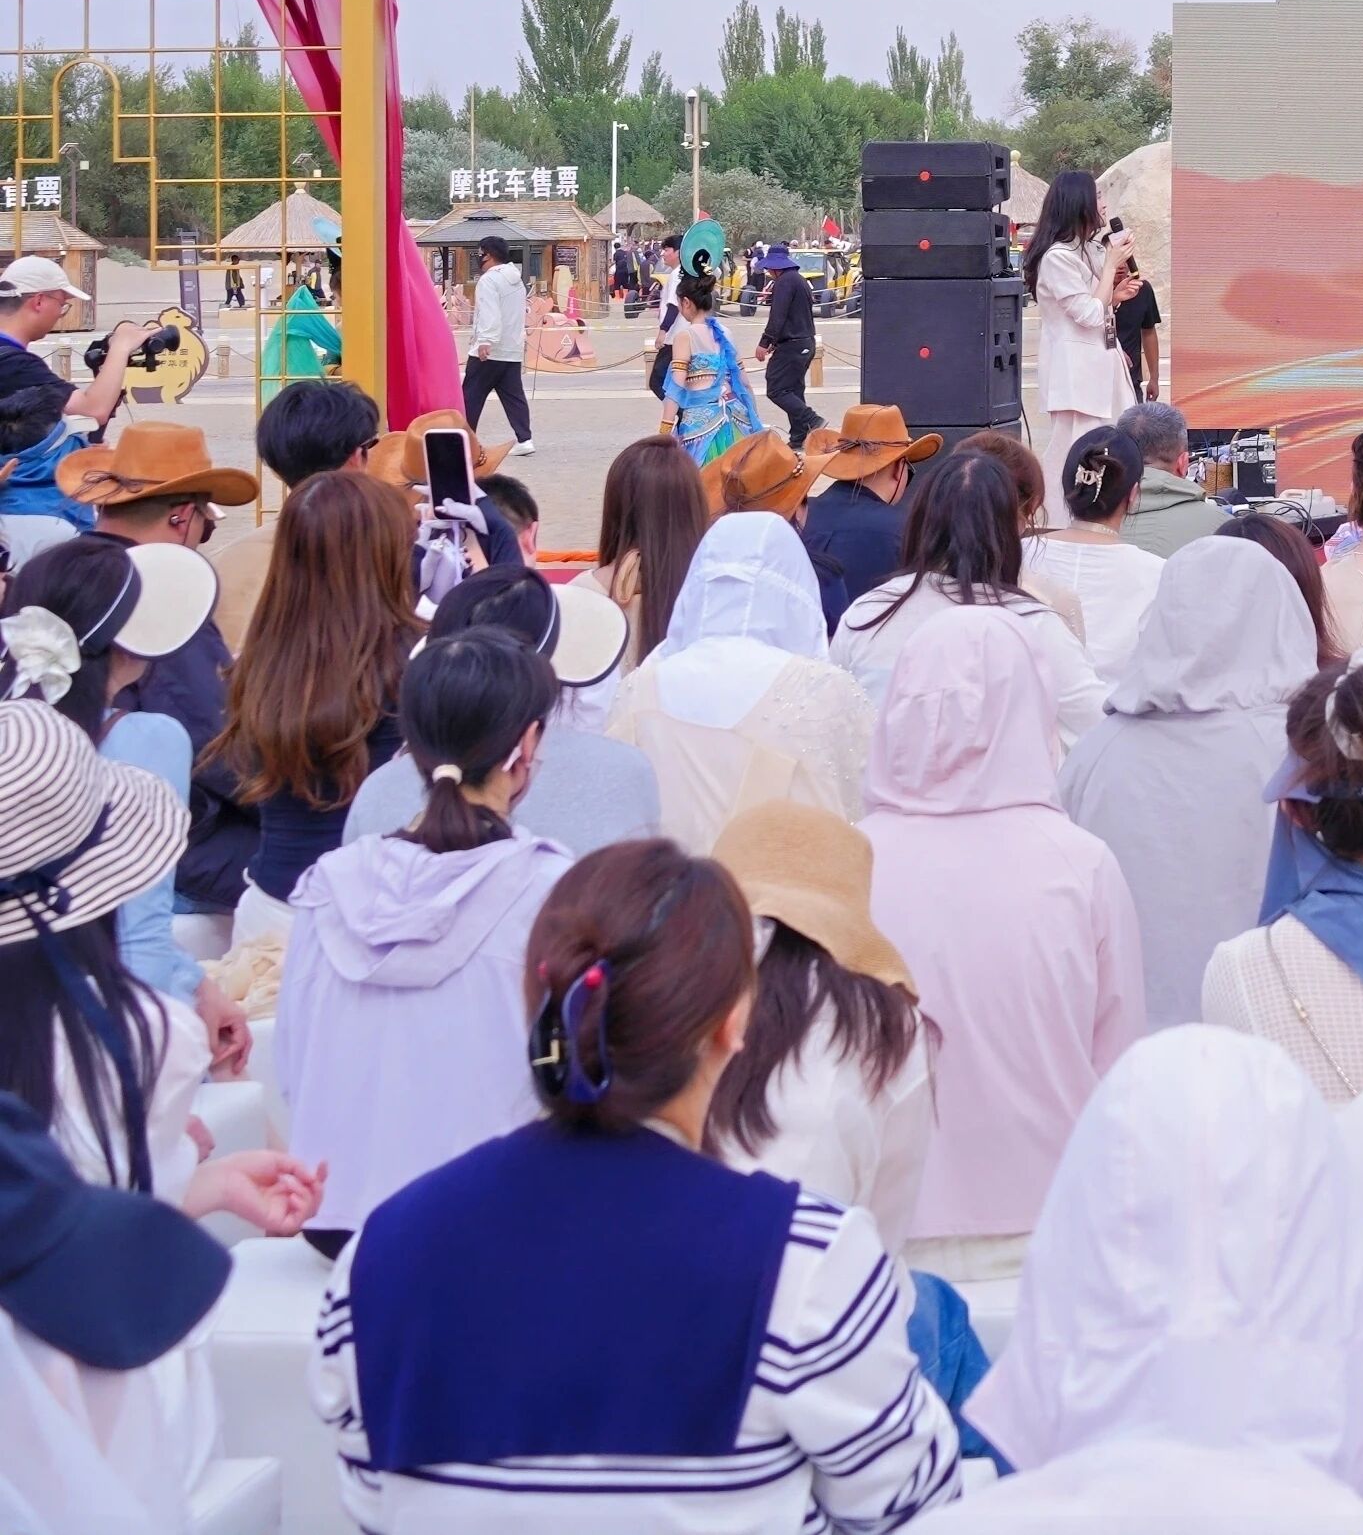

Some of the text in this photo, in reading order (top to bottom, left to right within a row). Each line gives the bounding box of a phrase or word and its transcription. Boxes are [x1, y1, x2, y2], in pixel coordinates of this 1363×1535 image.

[450, 165, 579, 199] 摩托车售票
